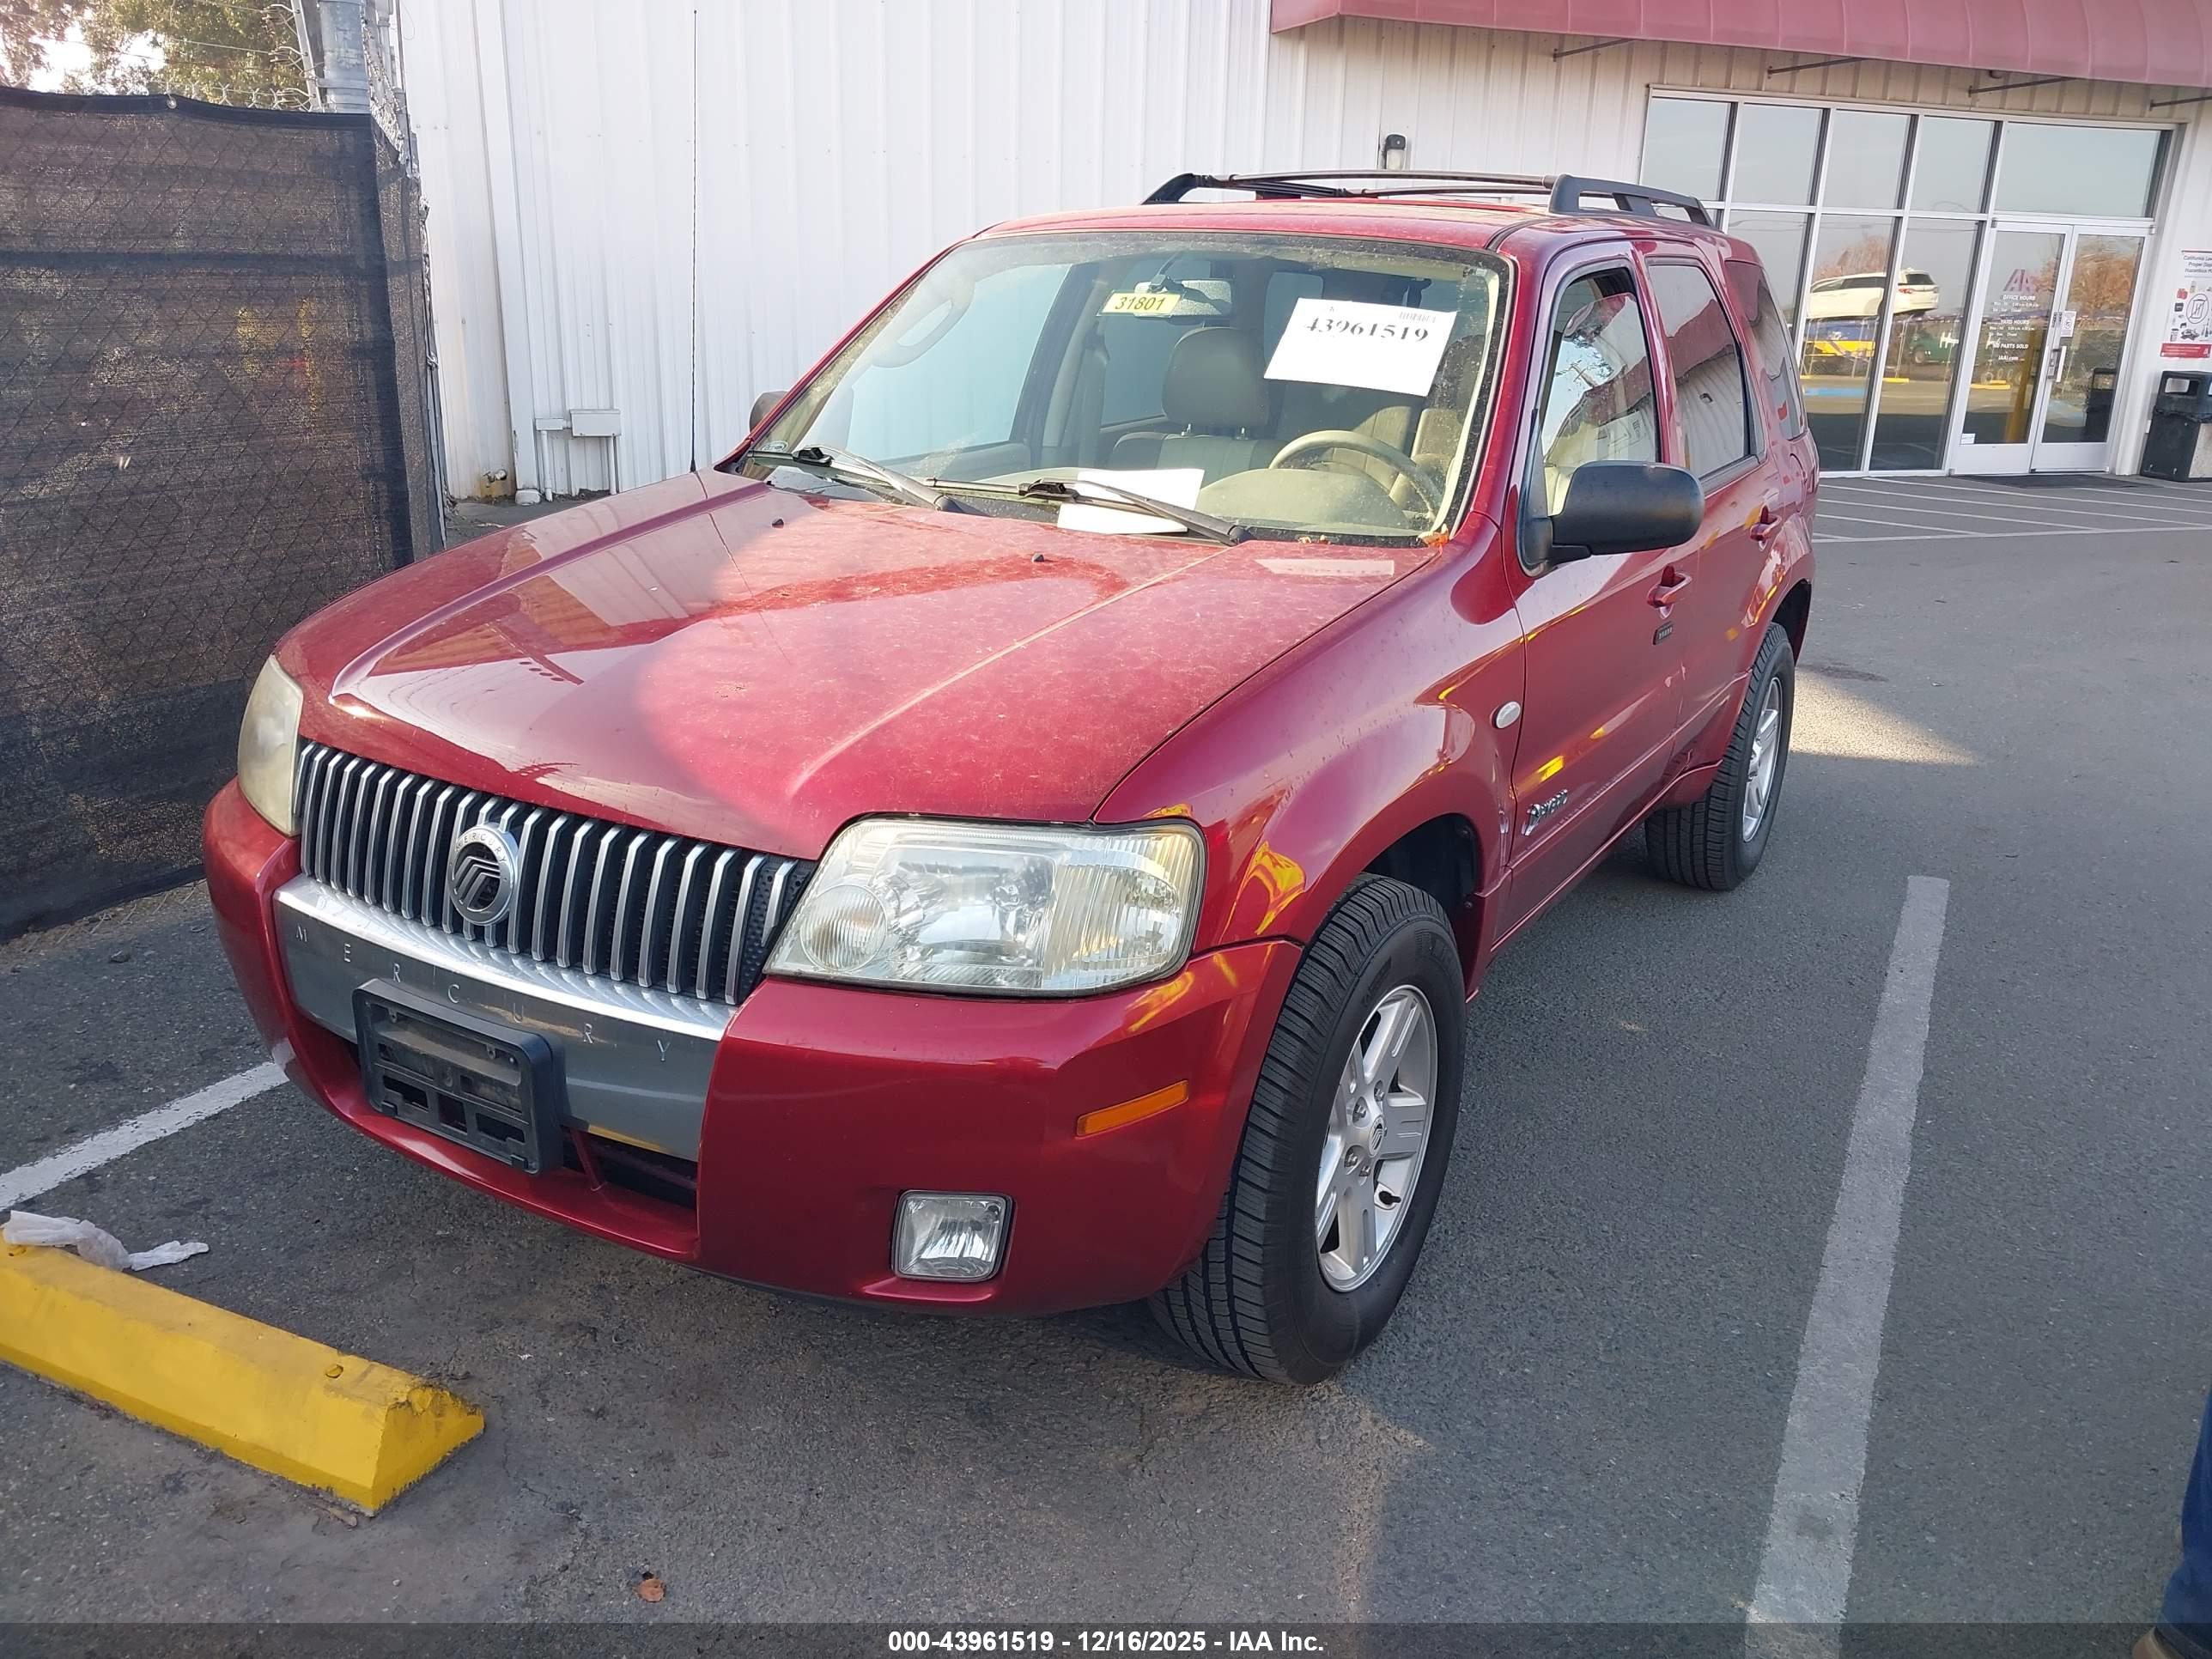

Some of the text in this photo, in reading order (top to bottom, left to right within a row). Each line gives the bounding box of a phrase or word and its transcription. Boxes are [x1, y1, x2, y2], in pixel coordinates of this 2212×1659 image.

[1115, 296, 1165, 310] 31801
[1305, 317, 1429, 342] 43961519
[455, 832, 507, 862] MERCURY
[295, 924, 671, 1061] MERCURY
